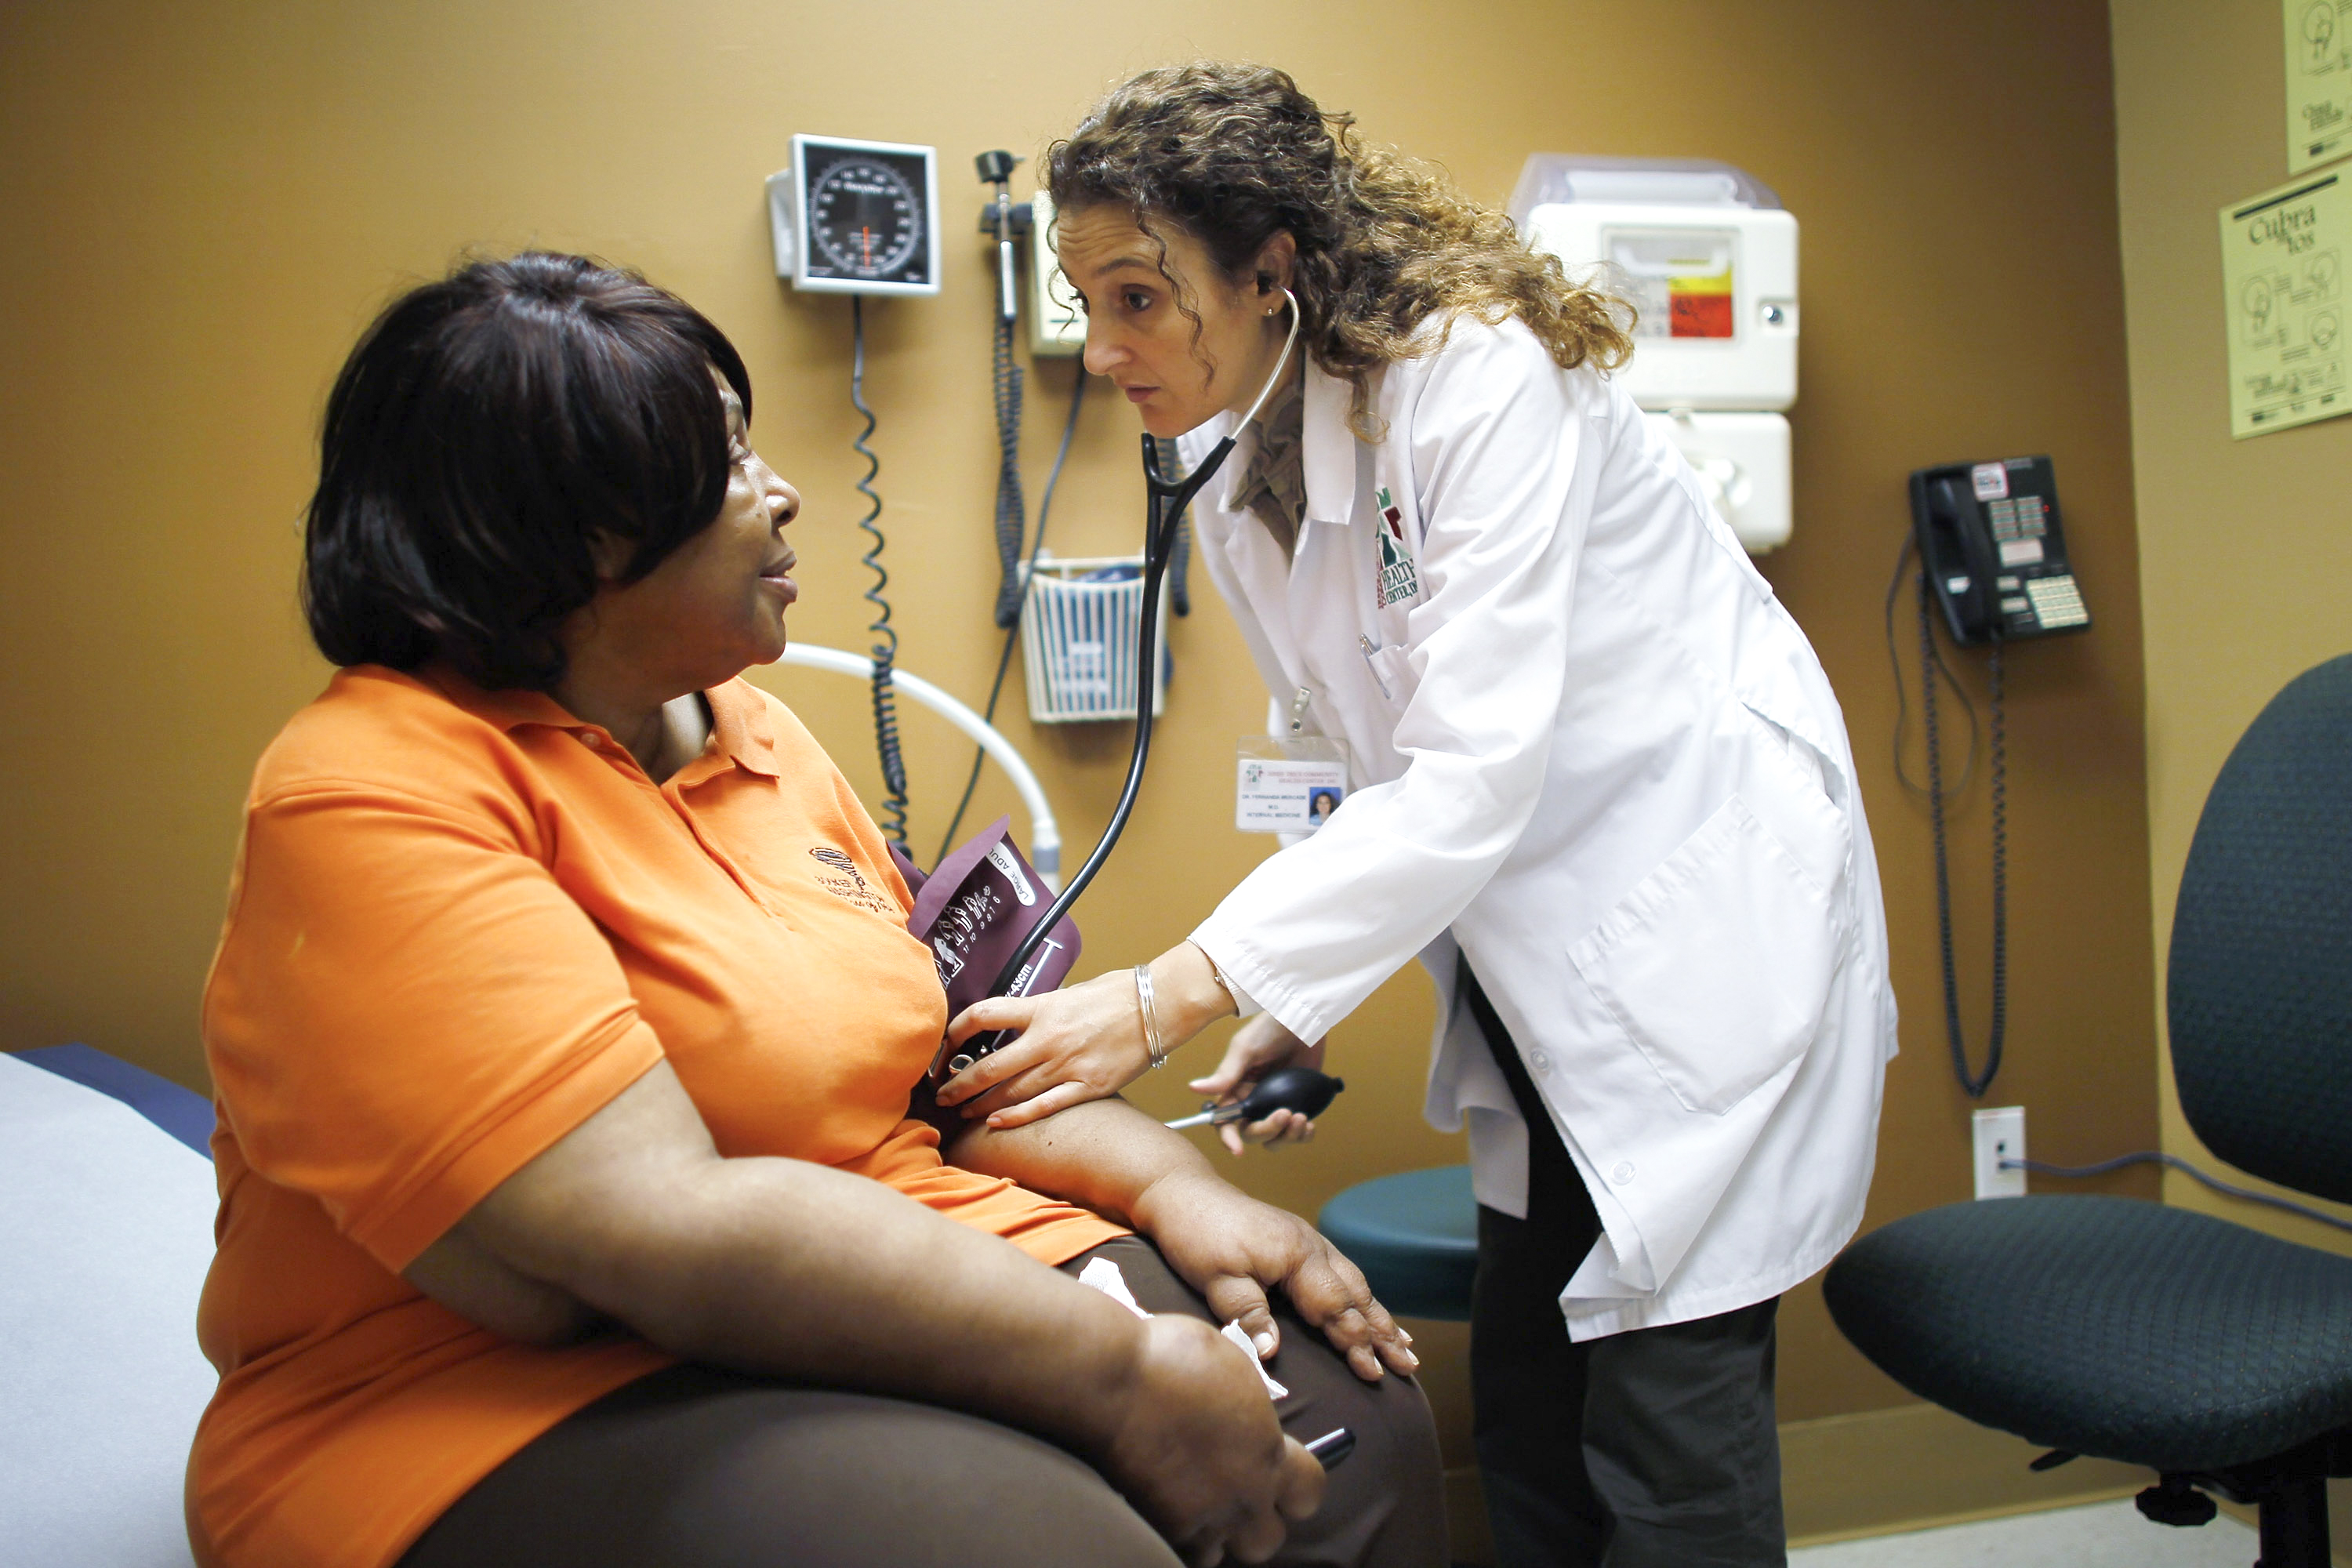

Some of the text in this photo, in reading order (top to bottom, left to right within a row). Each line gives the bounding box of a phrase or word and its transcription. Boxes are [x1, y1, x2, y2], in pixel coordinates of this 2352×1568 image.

[989, 848, 1029, 900] LARGE ADUL
[980, 921, 985, 930] 9
[970, 932, 976, 942] 10
